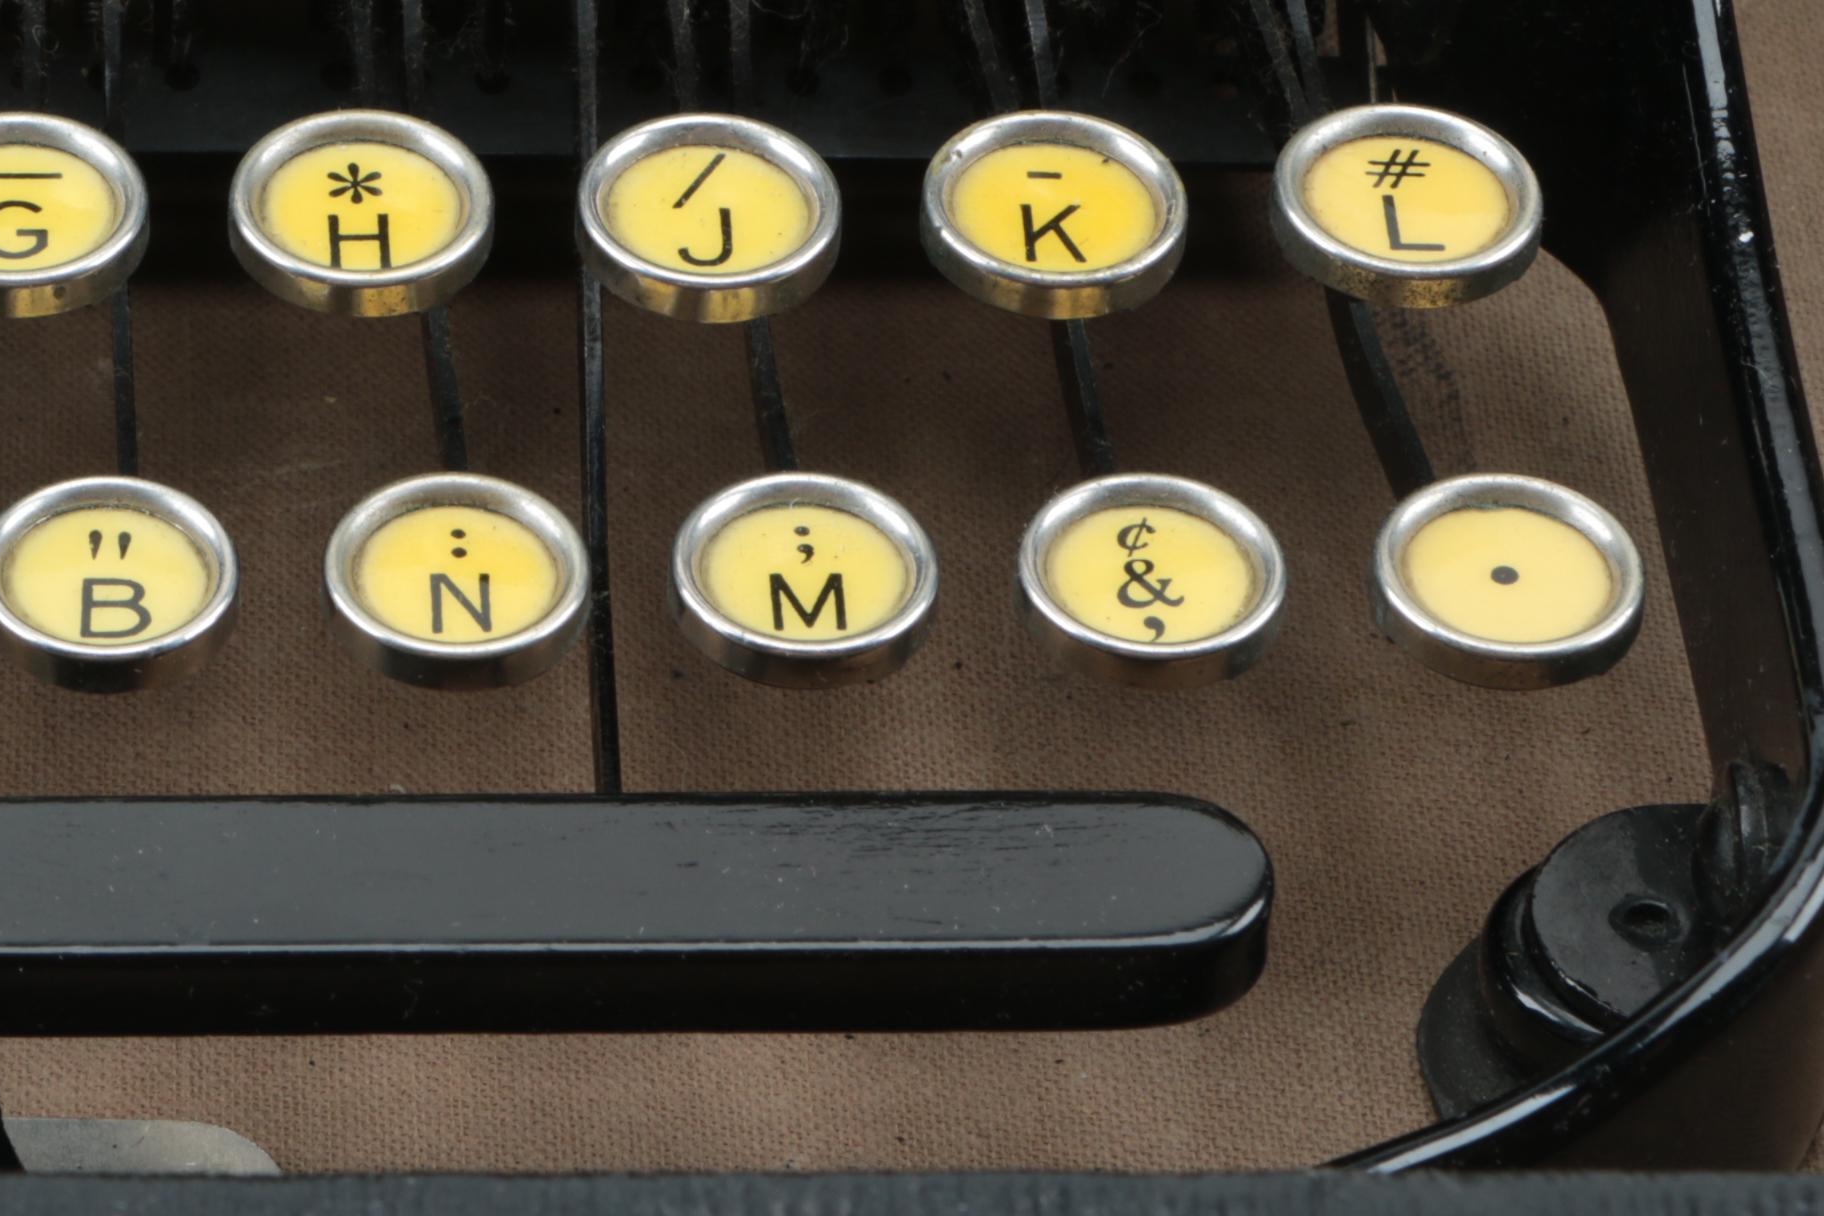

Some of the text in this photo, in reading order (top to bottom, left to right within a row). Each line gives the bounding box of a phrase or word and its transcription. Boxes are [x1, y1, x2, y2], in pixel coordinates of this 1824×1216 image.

[673, 153, 726, 208] /
[1366, 149, 1430, 189] #
[328, 213, 393, 270] H
[678, 208, 733, 266] J
[1019, 204, 1086, 264] K
[1382, 195, 1445, 251] L
[80, 578, 151, 638] B
[430, 573, 492, 633] N
[769, 573, 847, 631] M
[1117, 559, 1184, 608] &
